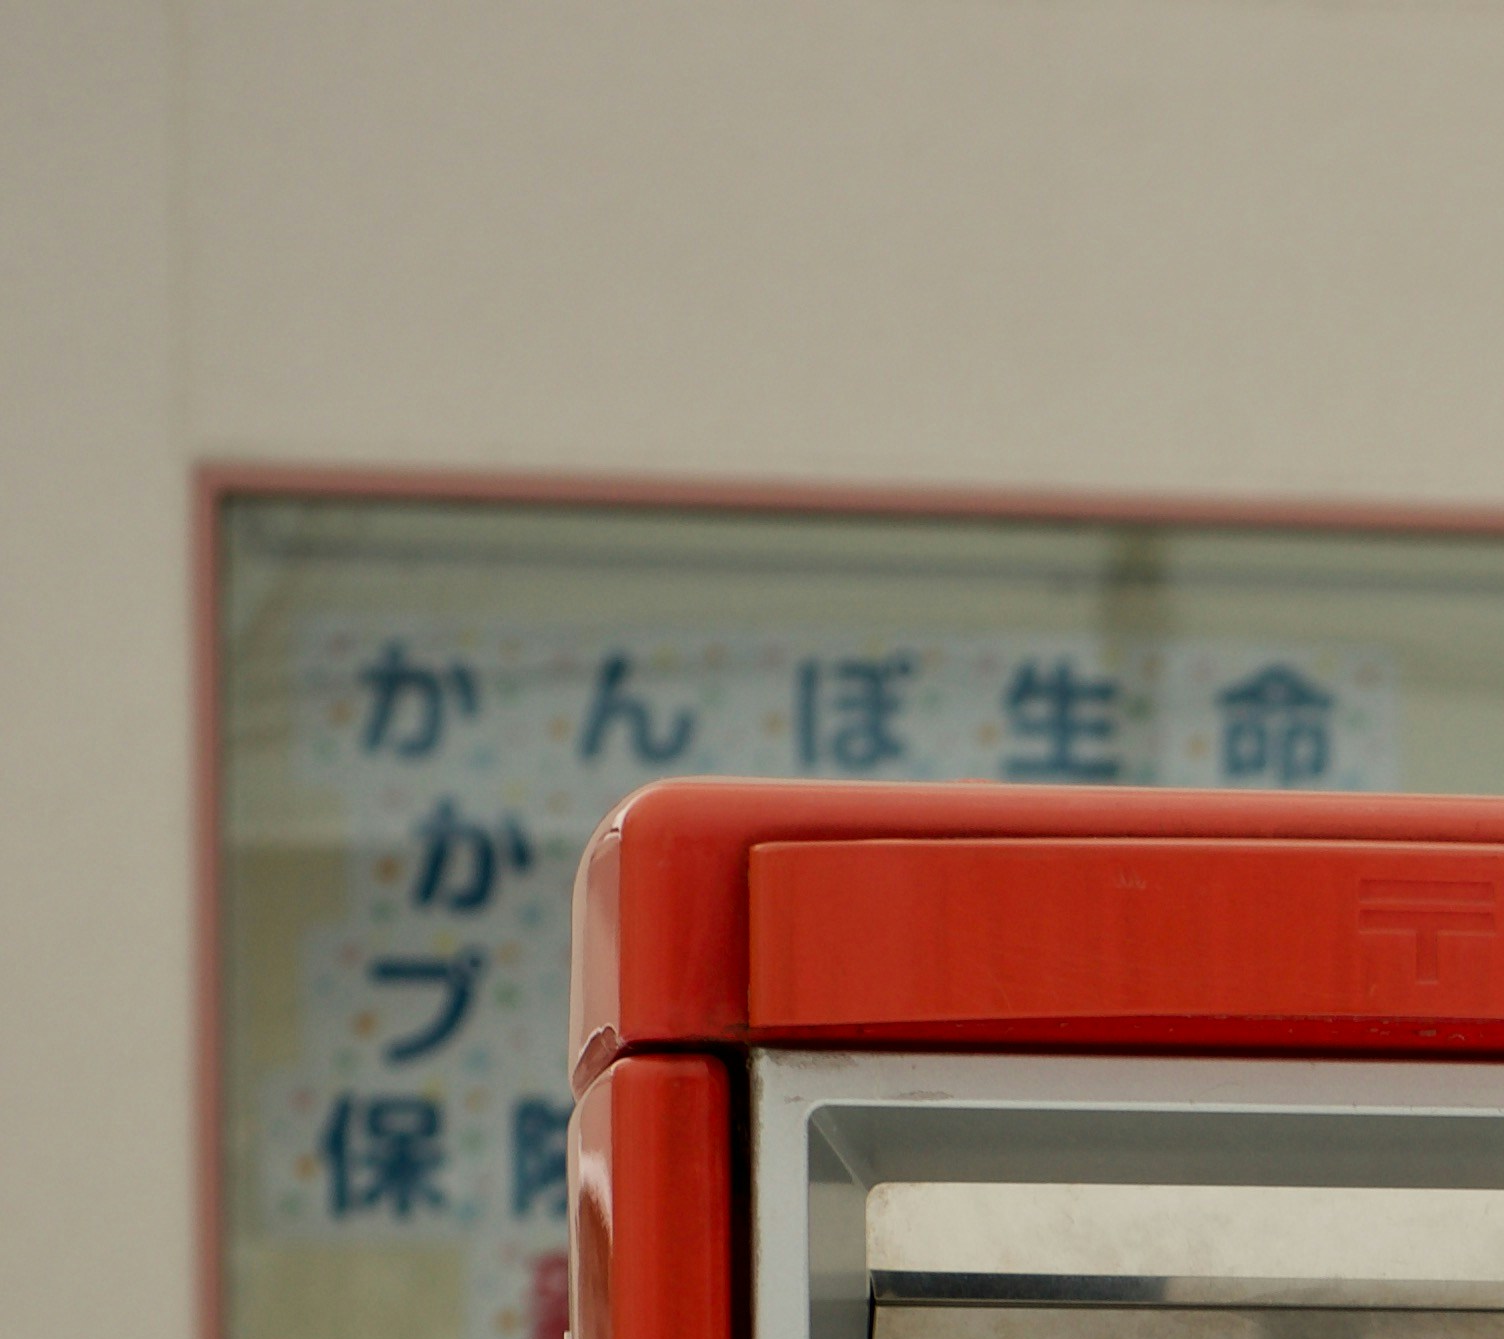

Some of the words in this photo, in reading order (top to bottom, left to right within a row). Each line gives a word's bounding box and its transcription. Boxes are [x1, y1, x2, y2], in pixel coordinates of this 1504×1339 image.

[360, 644, 1335, 784] かんぽ生命
